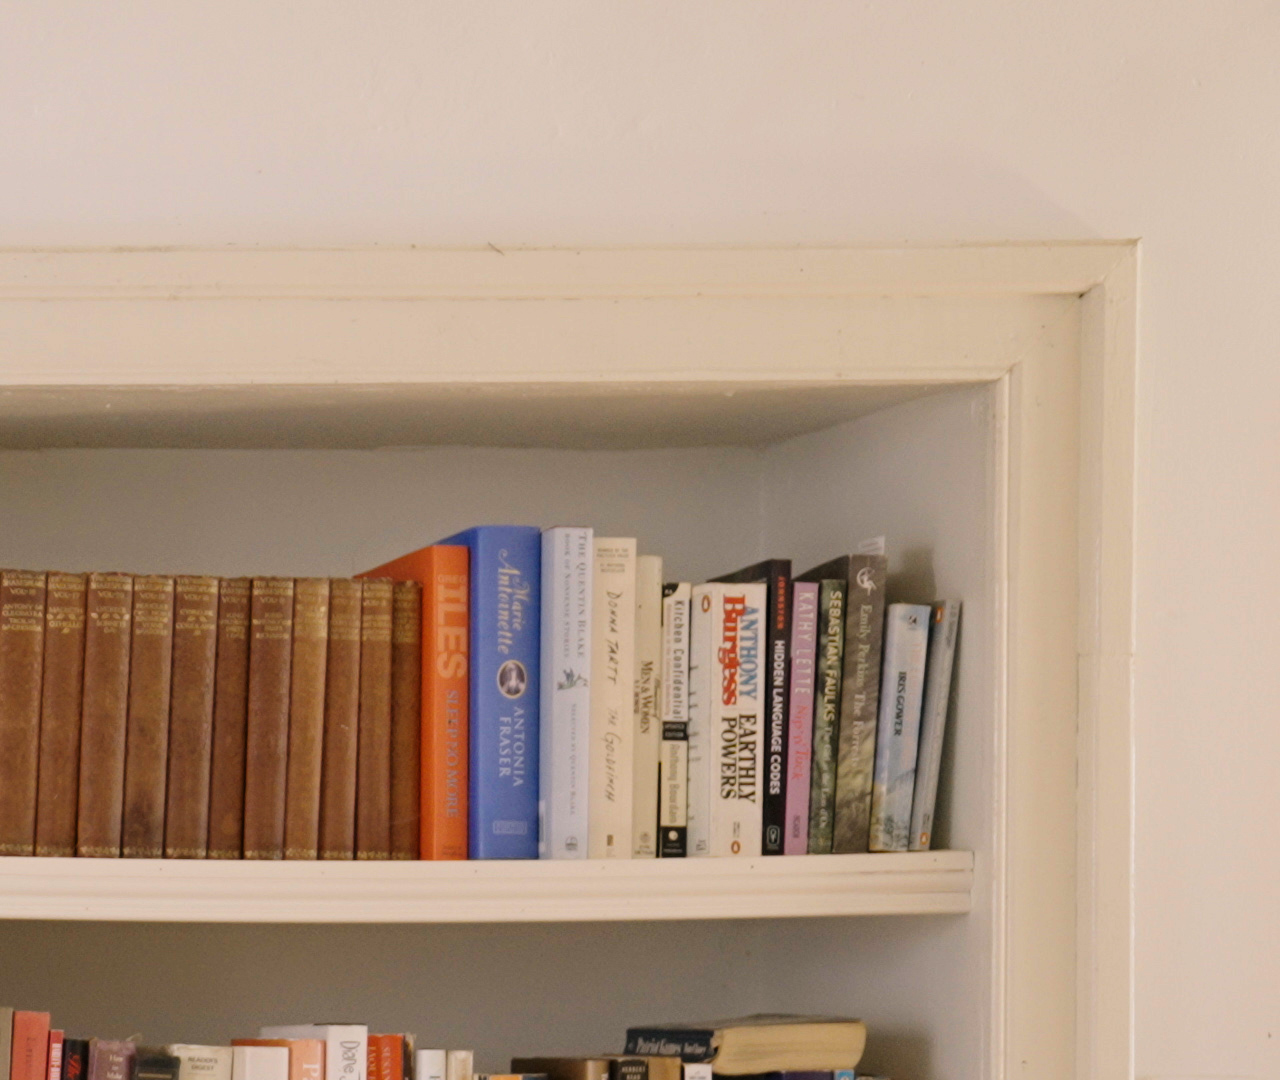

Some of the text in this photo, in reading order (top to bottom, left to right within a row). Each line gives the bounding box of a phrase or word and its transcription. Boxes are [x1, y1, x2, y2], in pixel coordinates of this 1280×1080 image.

[437, 587, 466, 679] ILES
[512, 578, 529, 632] Marie
[576, 533, 587, 659] THE QUENTIN BLAKE
[672, 600, 686, 720] Kitchen Confidential
[717, 594, 745, 706] Burgess
[739, 606, 759, 700] ANTHONY
[794, 592, 815, 694] KATHY LETTE
[822, 591, 842, 721] SEBASTIAN FAULKS
[499, 717, 511, 777] FRASER
[512, 706, 524, 787] ANTONIA
[770, 640, 785, 794] HIDDEN LANGUAGE CODES
[893, 671, 907, 737] IRIS GOWER
[720, 717, 738, 800] POWERS
[738, 714, 756, 804] EARTHLY
